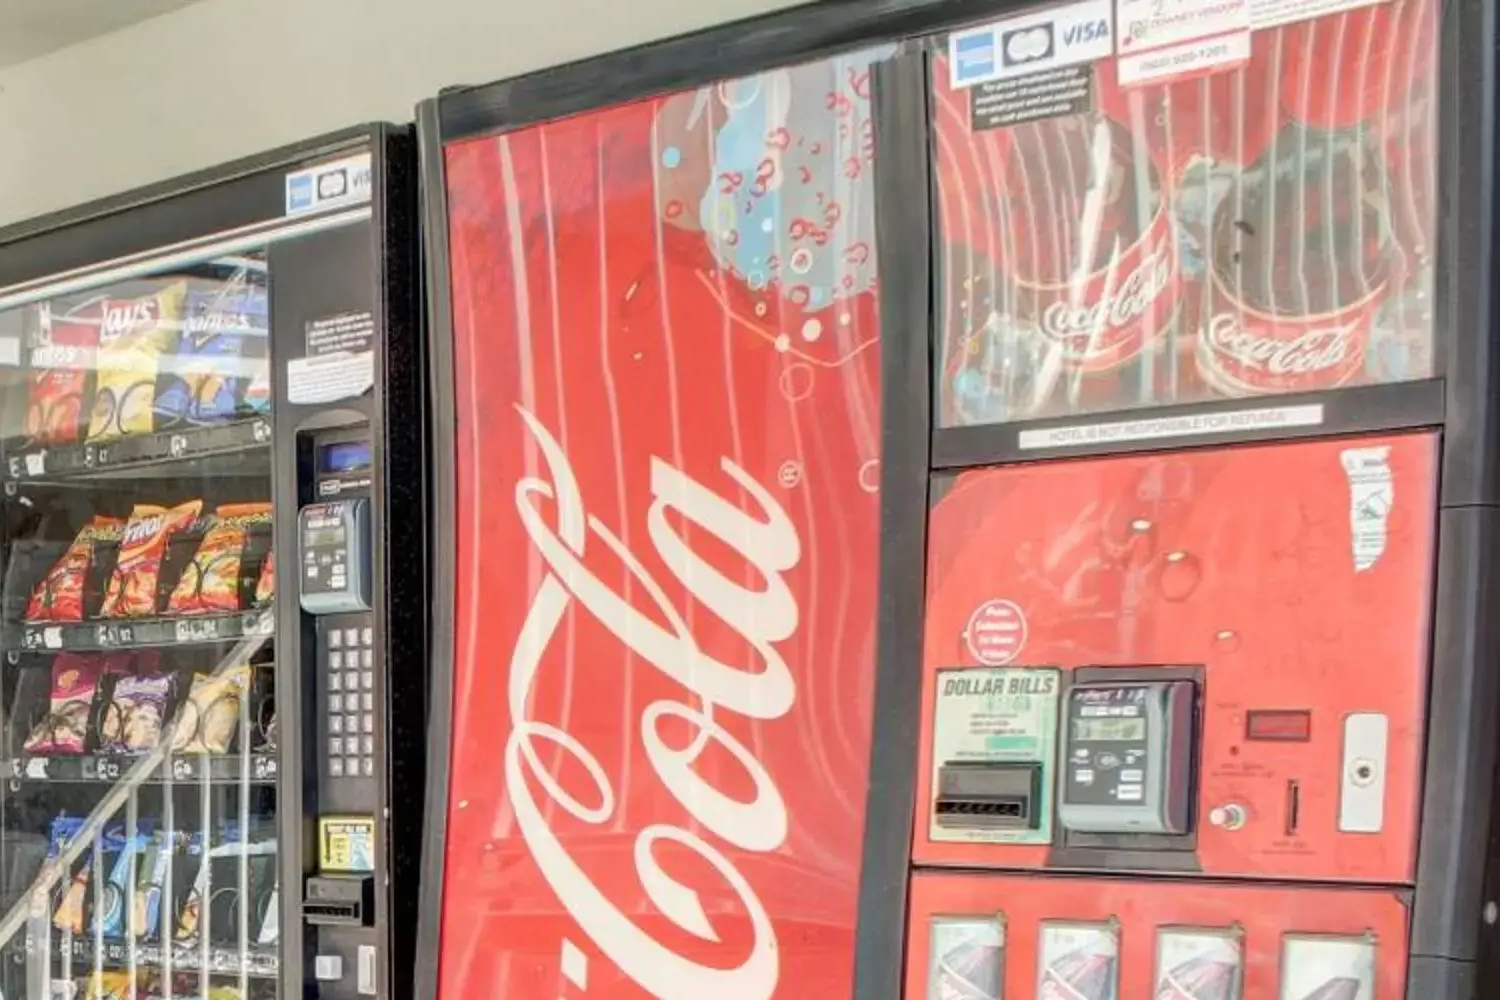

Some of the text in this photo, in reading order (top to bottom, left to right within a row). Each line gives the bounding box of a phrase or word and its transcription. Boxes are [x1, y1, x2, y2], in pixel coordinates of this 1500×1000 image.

[1062, 19, 1109, 46] VISA
[1049, 429, 1083, 443] HOTEL
[1100, 425, 1121, 440] NOT
[944, 677, 1054, 697] DOLLAR BILLS
